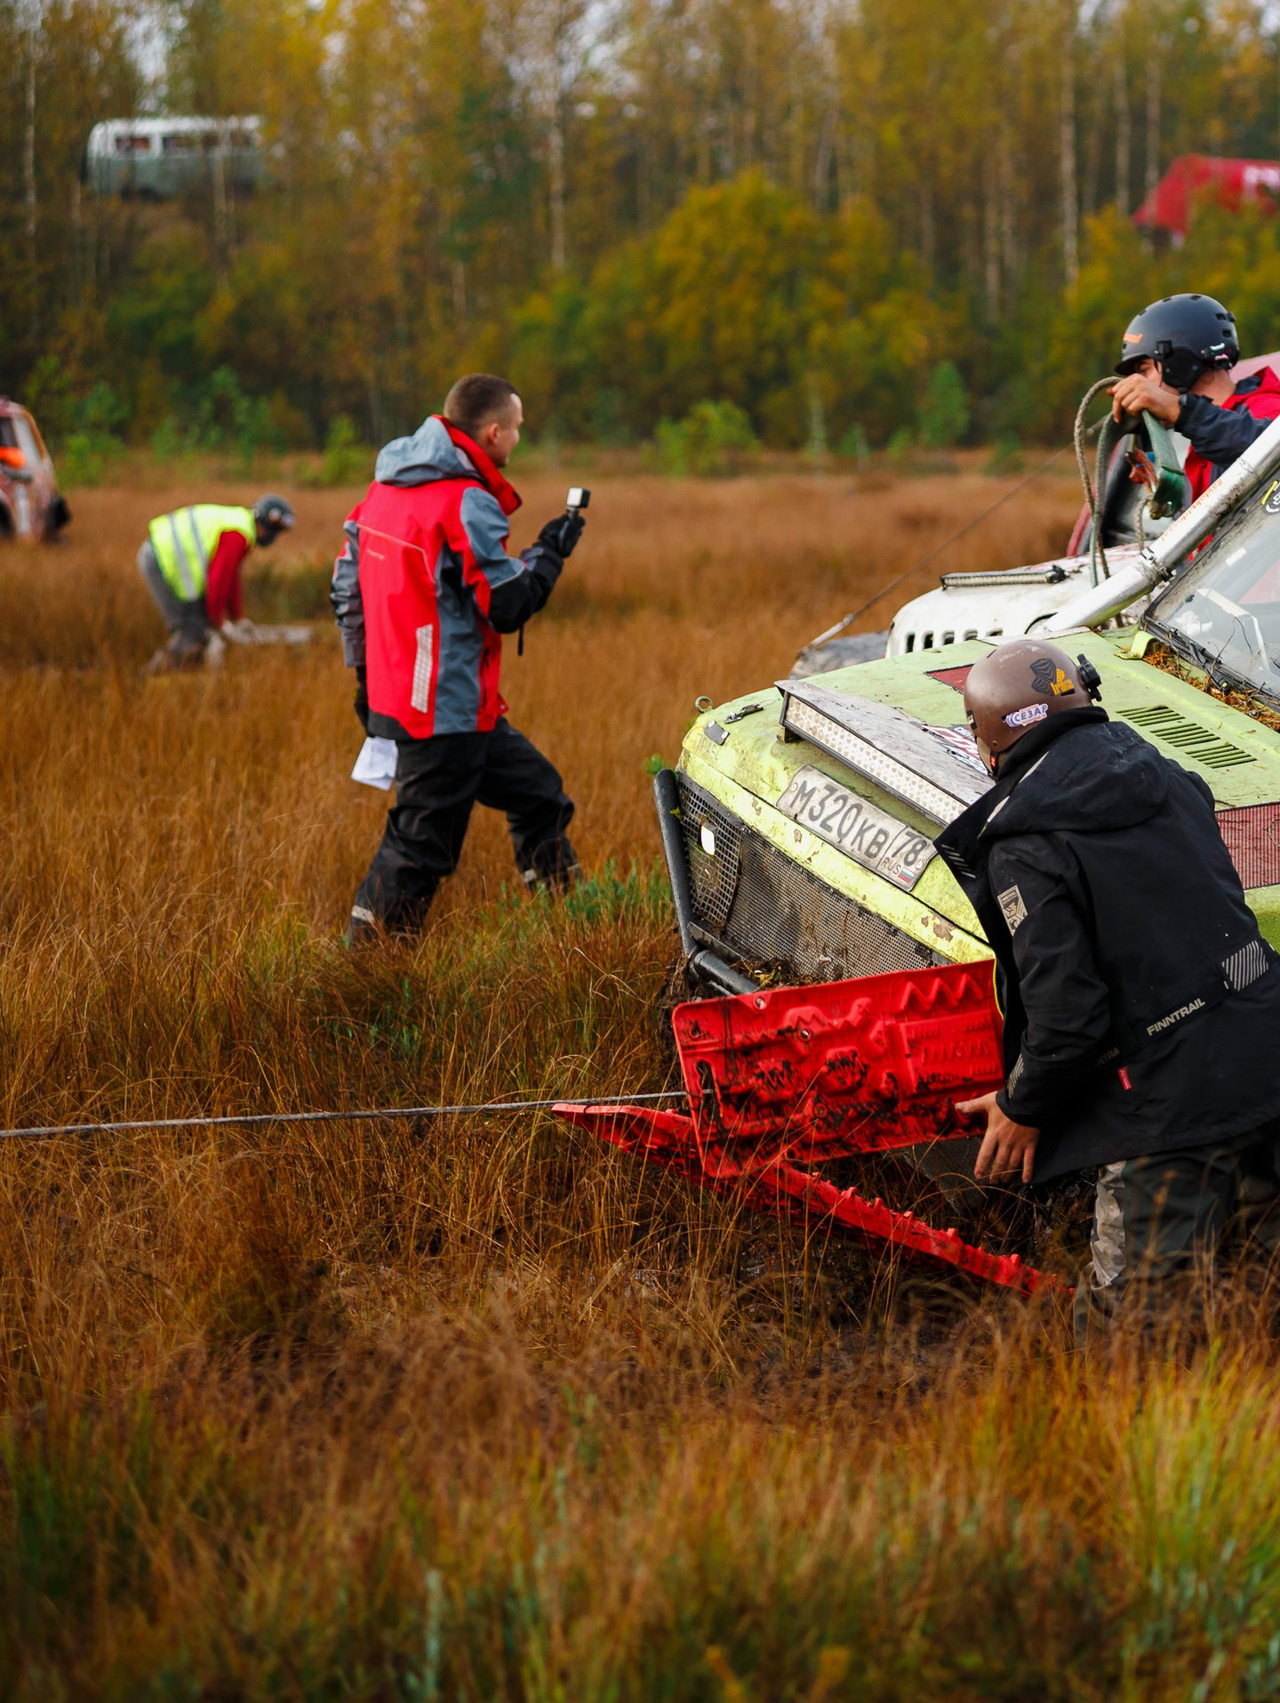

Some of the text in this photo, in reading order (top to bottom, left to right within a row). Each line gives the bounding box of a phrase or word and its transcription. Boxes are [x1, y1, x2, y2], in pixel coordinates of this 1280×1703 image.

[881, 857, 901, 876] RUS
[891, 832, 927, 867] 78
[1146, 997, 1206, 1037] FINNTRAIL
